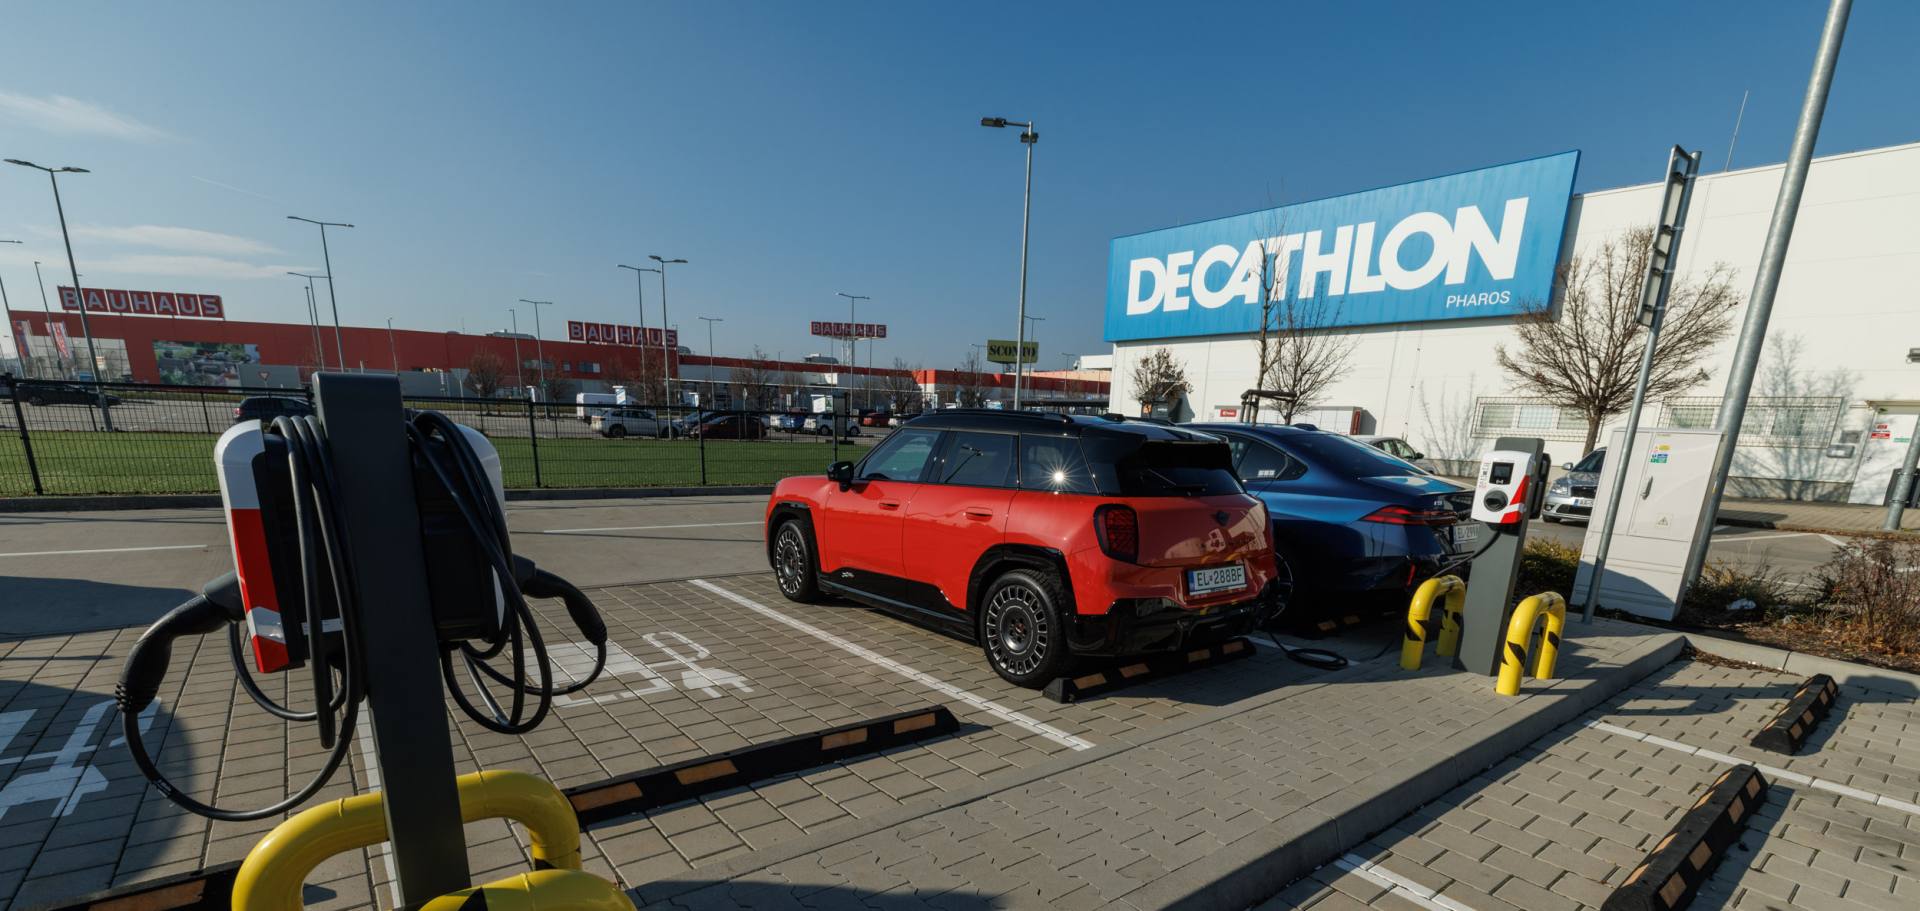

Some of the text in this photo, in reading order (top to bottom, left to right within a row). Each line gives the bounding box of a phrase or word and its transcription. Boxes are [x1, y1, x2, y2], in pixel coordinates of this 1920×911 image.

[1126, 196, 1529, 315] DECATHLON
[62, 289, 220, 314] BAUHAUS
[1446, 290, 1511, 309] PHAROS
[570, 322, 677, 346] BAUHAUS
[813, 322, 885, 337] BAUHAUS
